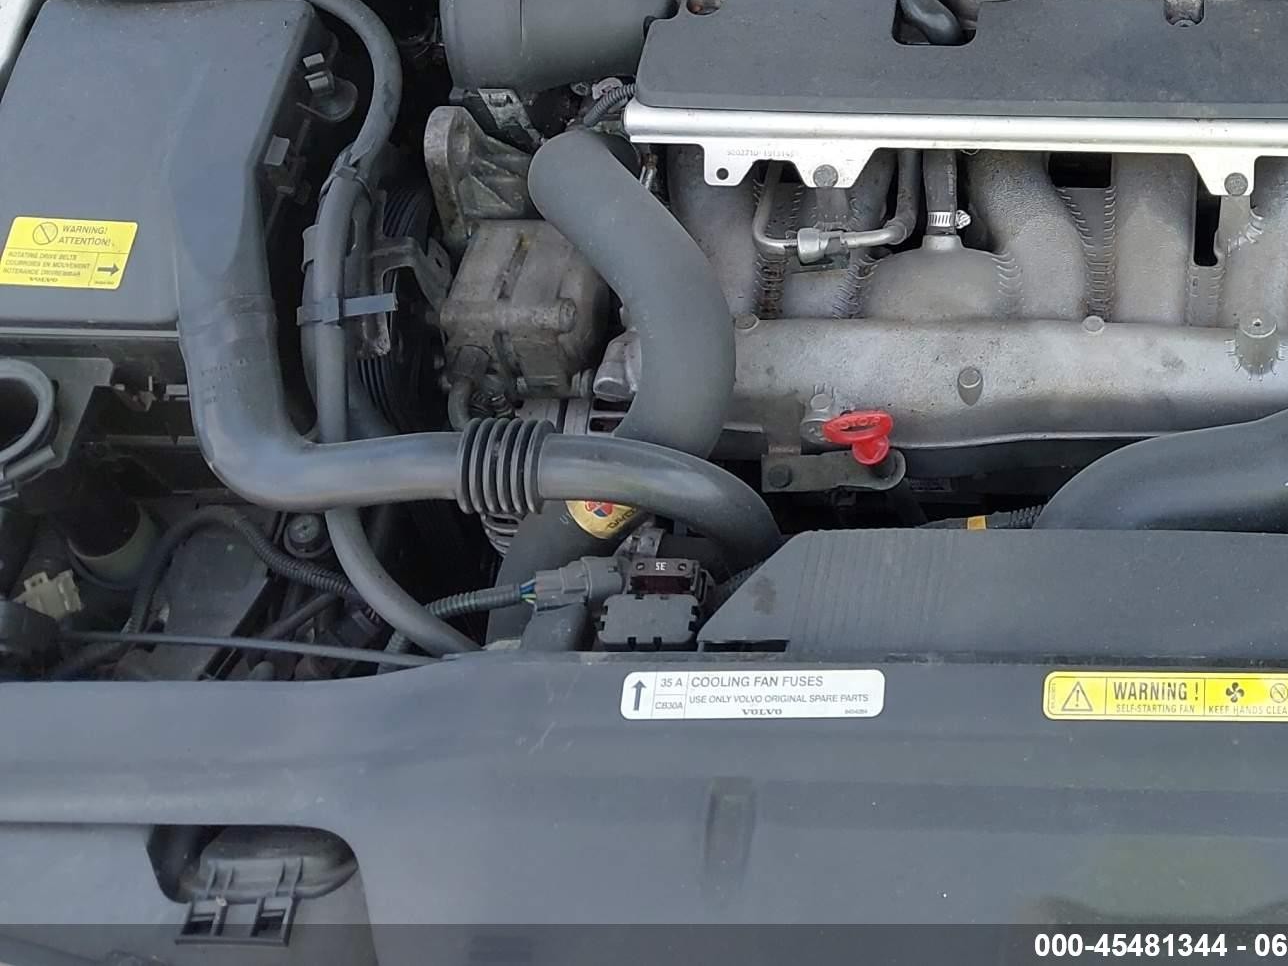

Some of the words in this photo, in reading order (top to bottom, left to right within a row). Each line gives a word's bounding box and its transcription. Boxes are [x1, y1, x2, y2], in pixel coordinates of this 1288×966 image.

[62, 225, 108, 234] WARNING!
[57, 236, 111, 246] ATTENTION!
[655, 561, 667, 571] SE
[660, 678, 673, 687] 35
[675, 678, 683, 687] A
[691, 676, 750, 687] COOLING
[754, 676, 779, 687] FAN
[782, 676, 823, 687] FUSES
[1113, 682, 1187, 700] WARNING
[1195, 682, 1199, 700] !
[690, 694, 708, 704] USE
[709, 694, 732, 703] ONLY
[733, 694, 763, 703] VOLVO
[765, 694, 807, 703] ORIGINAL
[809, 694, 838, 703] SPARE
[840, 693, 869, 702] PARTS
[1116, 704, 1176, 713] SELF-STARTING
[1180, 705, 1195, 713] FAN
[1209, 706, 1230, 714] KEEP
[1232, 706, 1263, 715] HANDS
